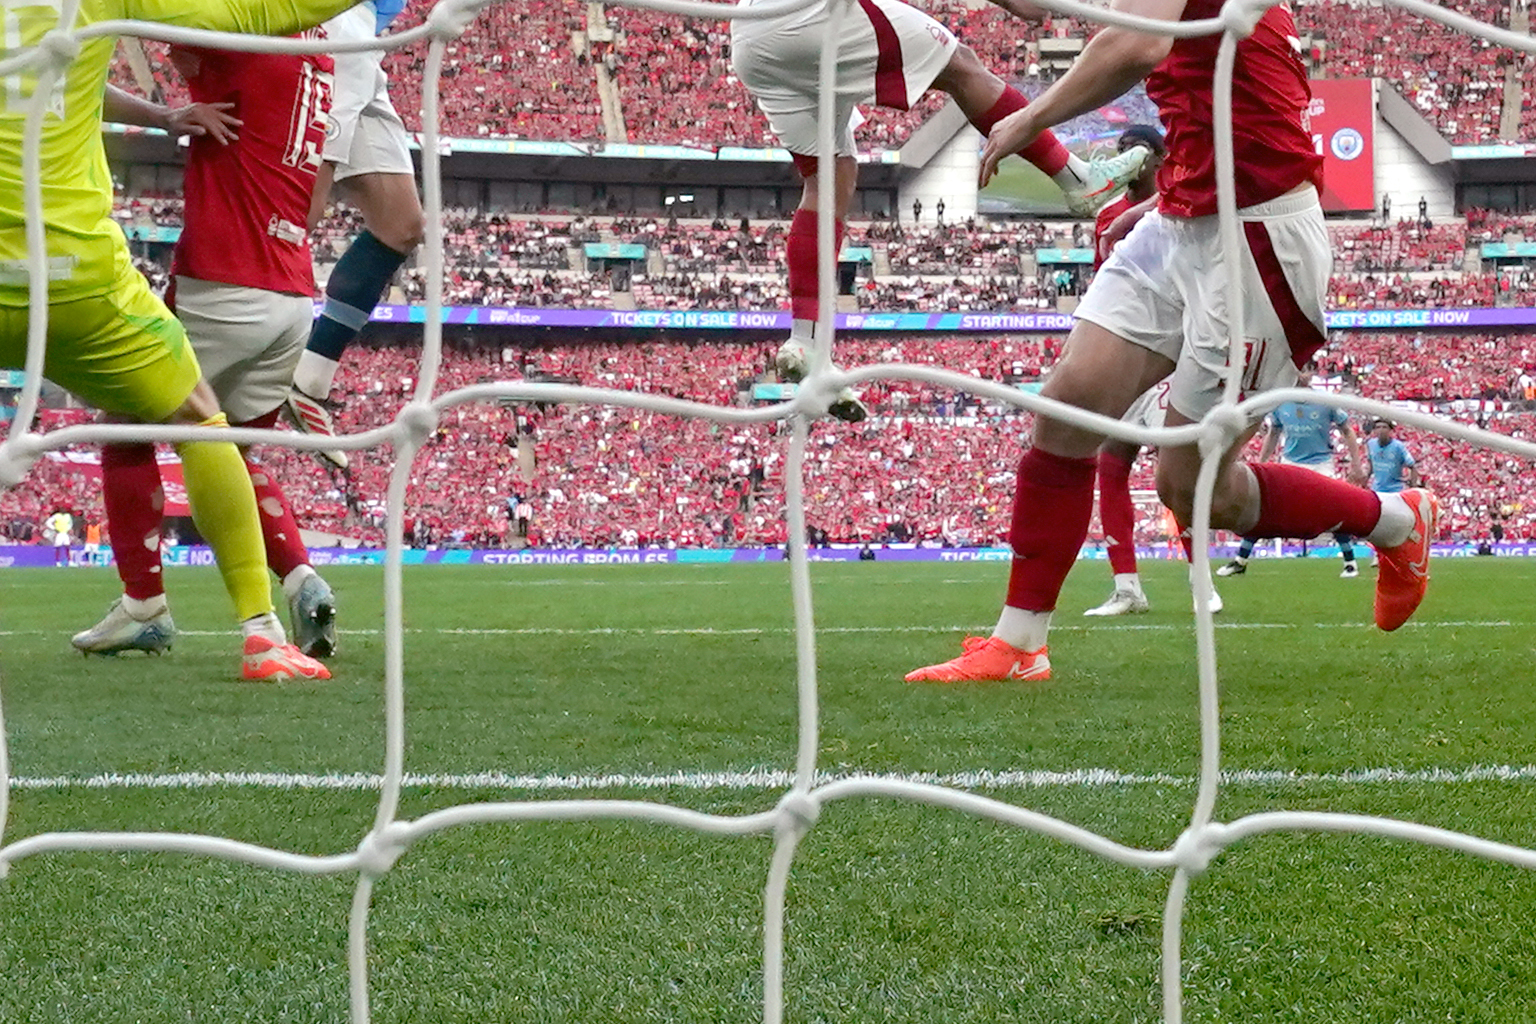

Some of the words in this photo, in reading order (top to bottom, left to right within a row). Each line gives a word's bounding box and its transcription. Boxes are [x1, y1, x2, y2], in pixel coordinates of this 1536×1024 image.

[611, 312, 672, 326] TICKETS
[674, 312, 697, 326] ON
[700, 312, 737, 326] SALE
[740, 314, 776, 326] NOW
[963, 315, 1033, 328] STARTING
[1324, 312, 1368, 326] CKETS
[1369, 311, 1392, 325] ON
[1394, 311, 1430, 324] SALE
[1433, 310, 1469, 324] NOW
